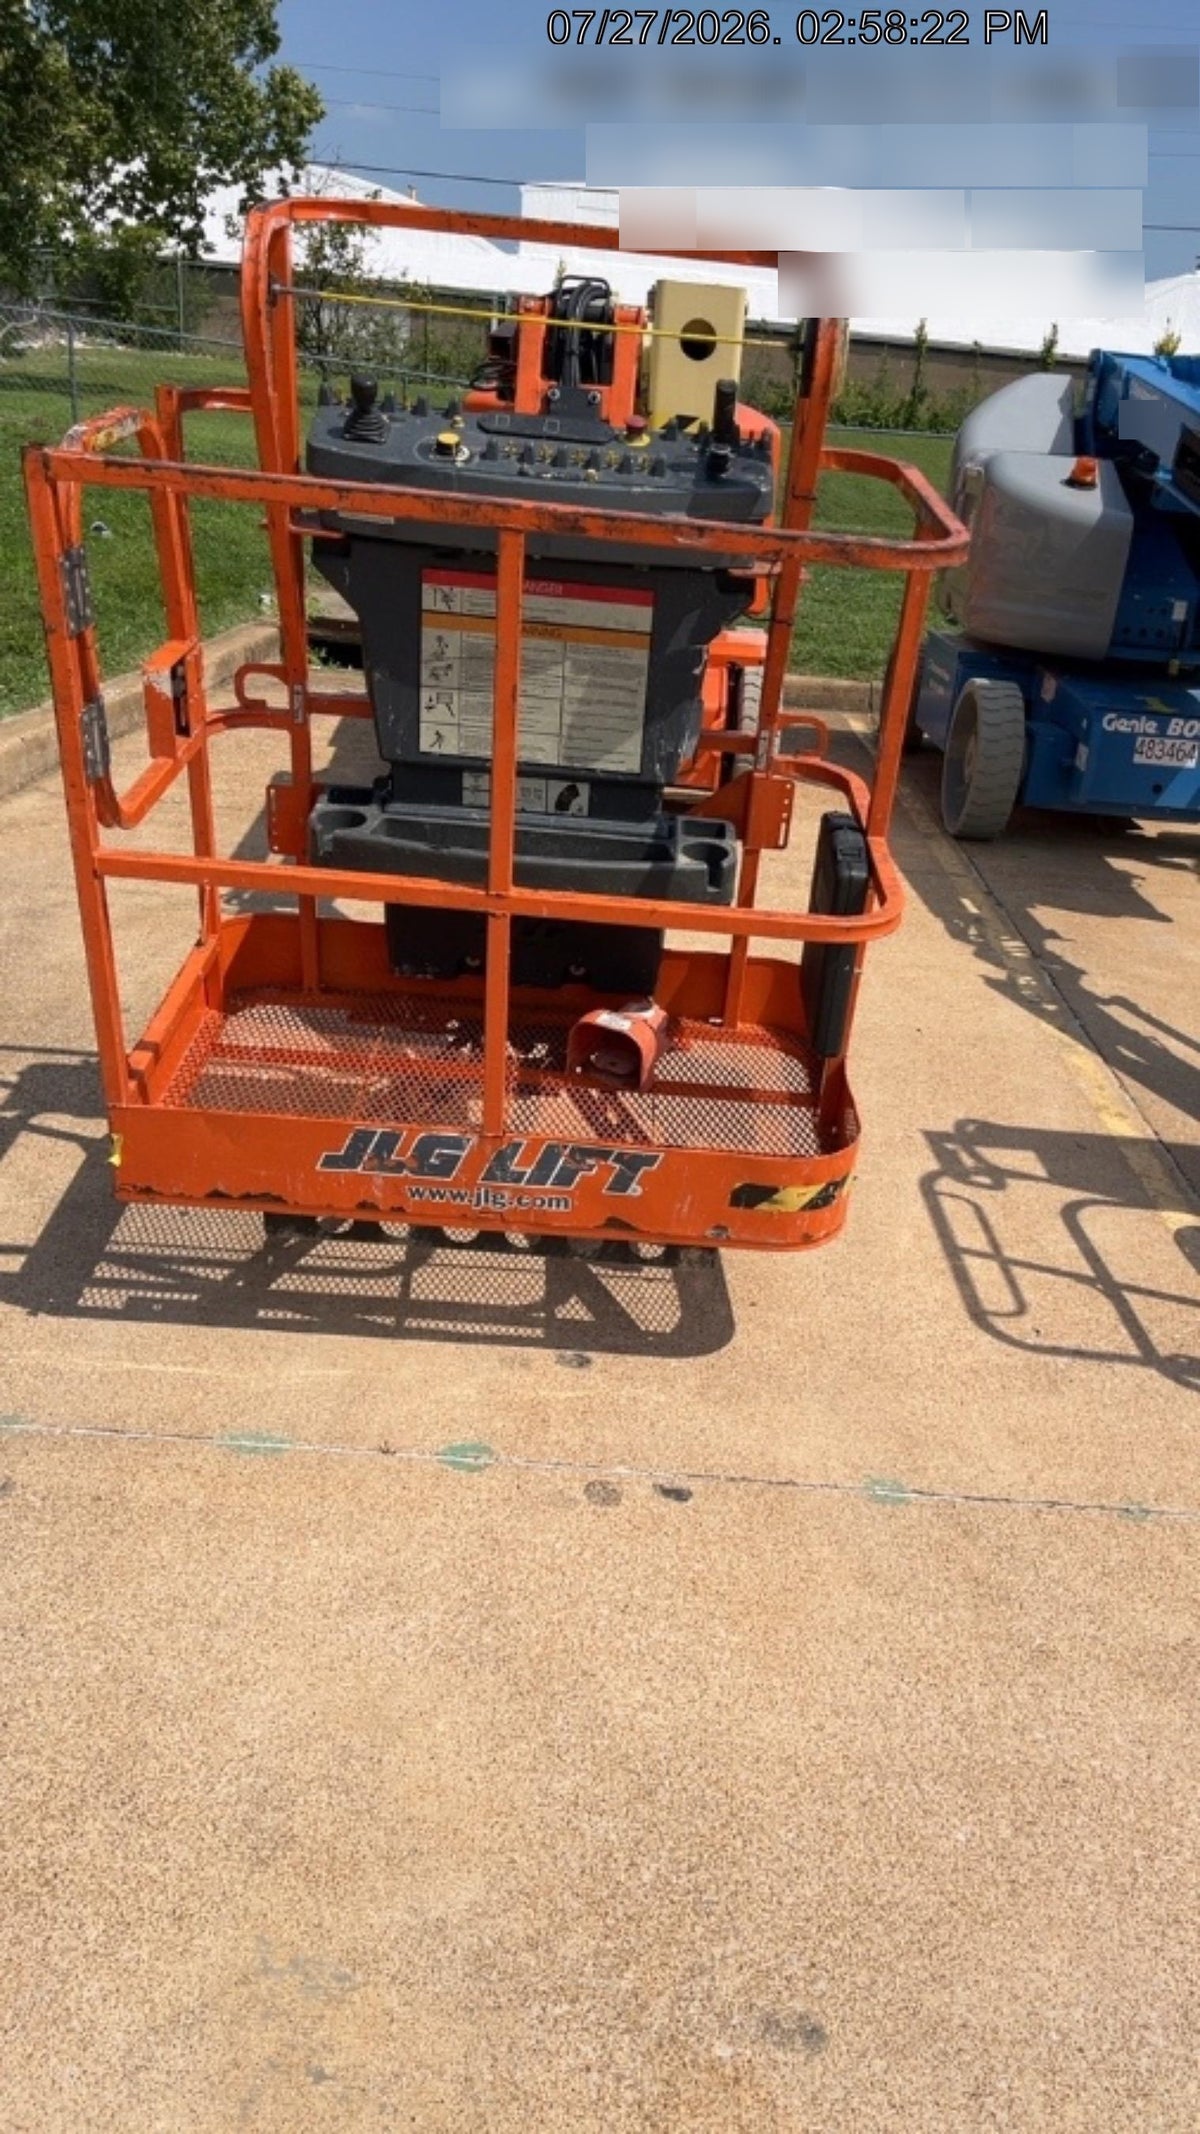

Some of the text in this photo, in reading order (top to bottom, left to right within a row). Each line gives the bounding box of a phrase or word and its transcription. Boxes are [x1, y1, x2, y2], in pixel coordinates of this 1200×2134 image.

[522, 580, 563, 595] ANGER
[1102, 713, 1200, 738] Genie BO
[1135, 739, 1196, 762] 483464
[315, 1126, 665, 1195] JLG LIFT
[406, 1184, 573, 1211] www.jlg.com
